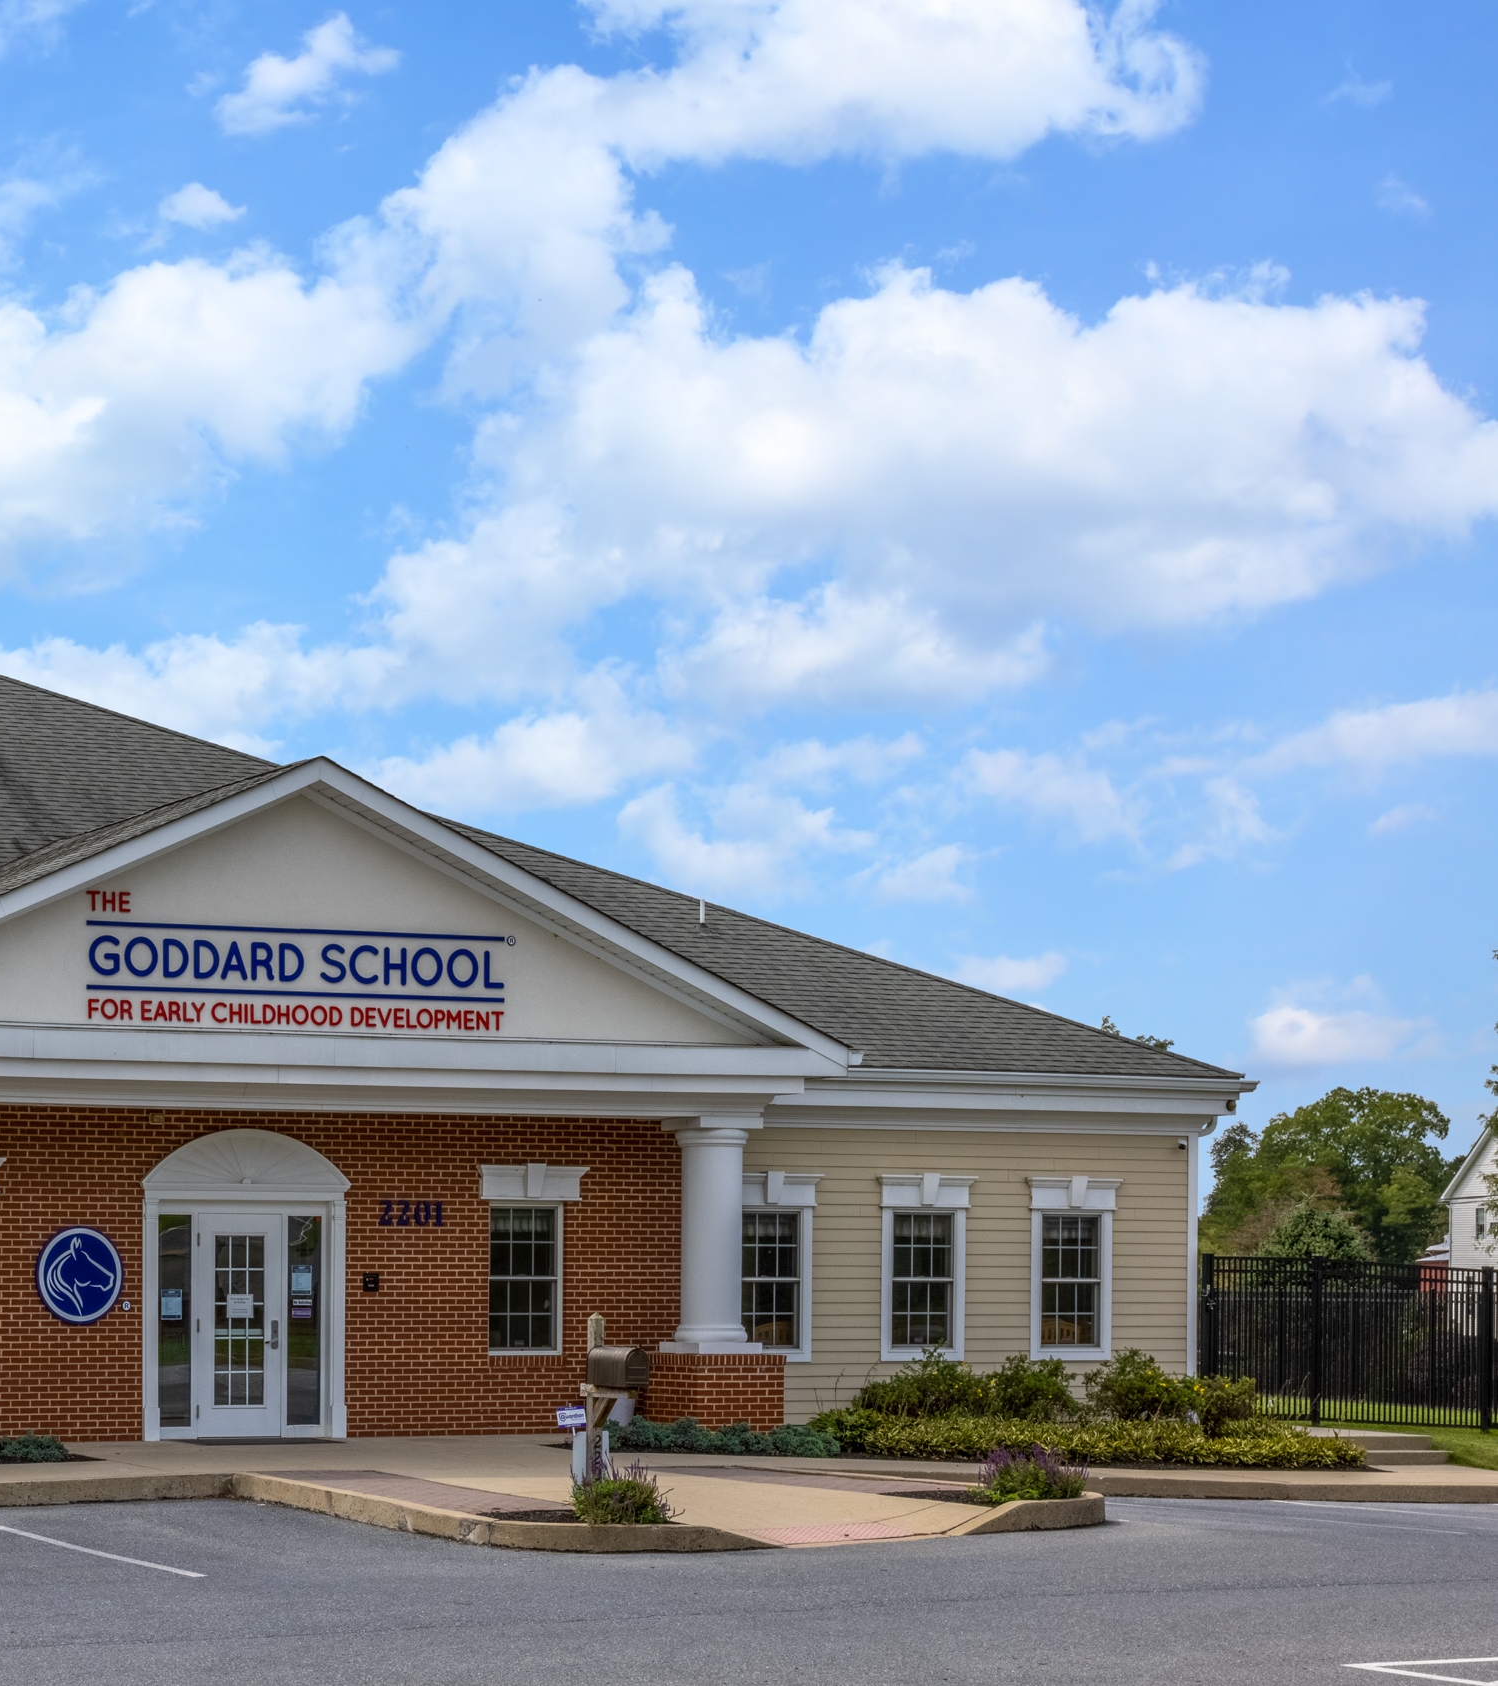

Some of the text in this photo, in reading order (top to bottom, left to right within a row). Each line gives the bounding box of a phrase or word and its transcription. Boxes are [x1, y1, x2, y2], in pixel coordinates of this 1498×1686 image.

[86, 890, 131, 913] THE
[88, 934, 305, 983] GODDARD
[320, 943, 505, 989] SCHOOL
[87, 997, 505, 1032] FOR EARLY CHILDHOOD DEVELOPMENT
[378, 1199, 444, 1227] 2201
[558, 1412, 584, 1422] Guardian
